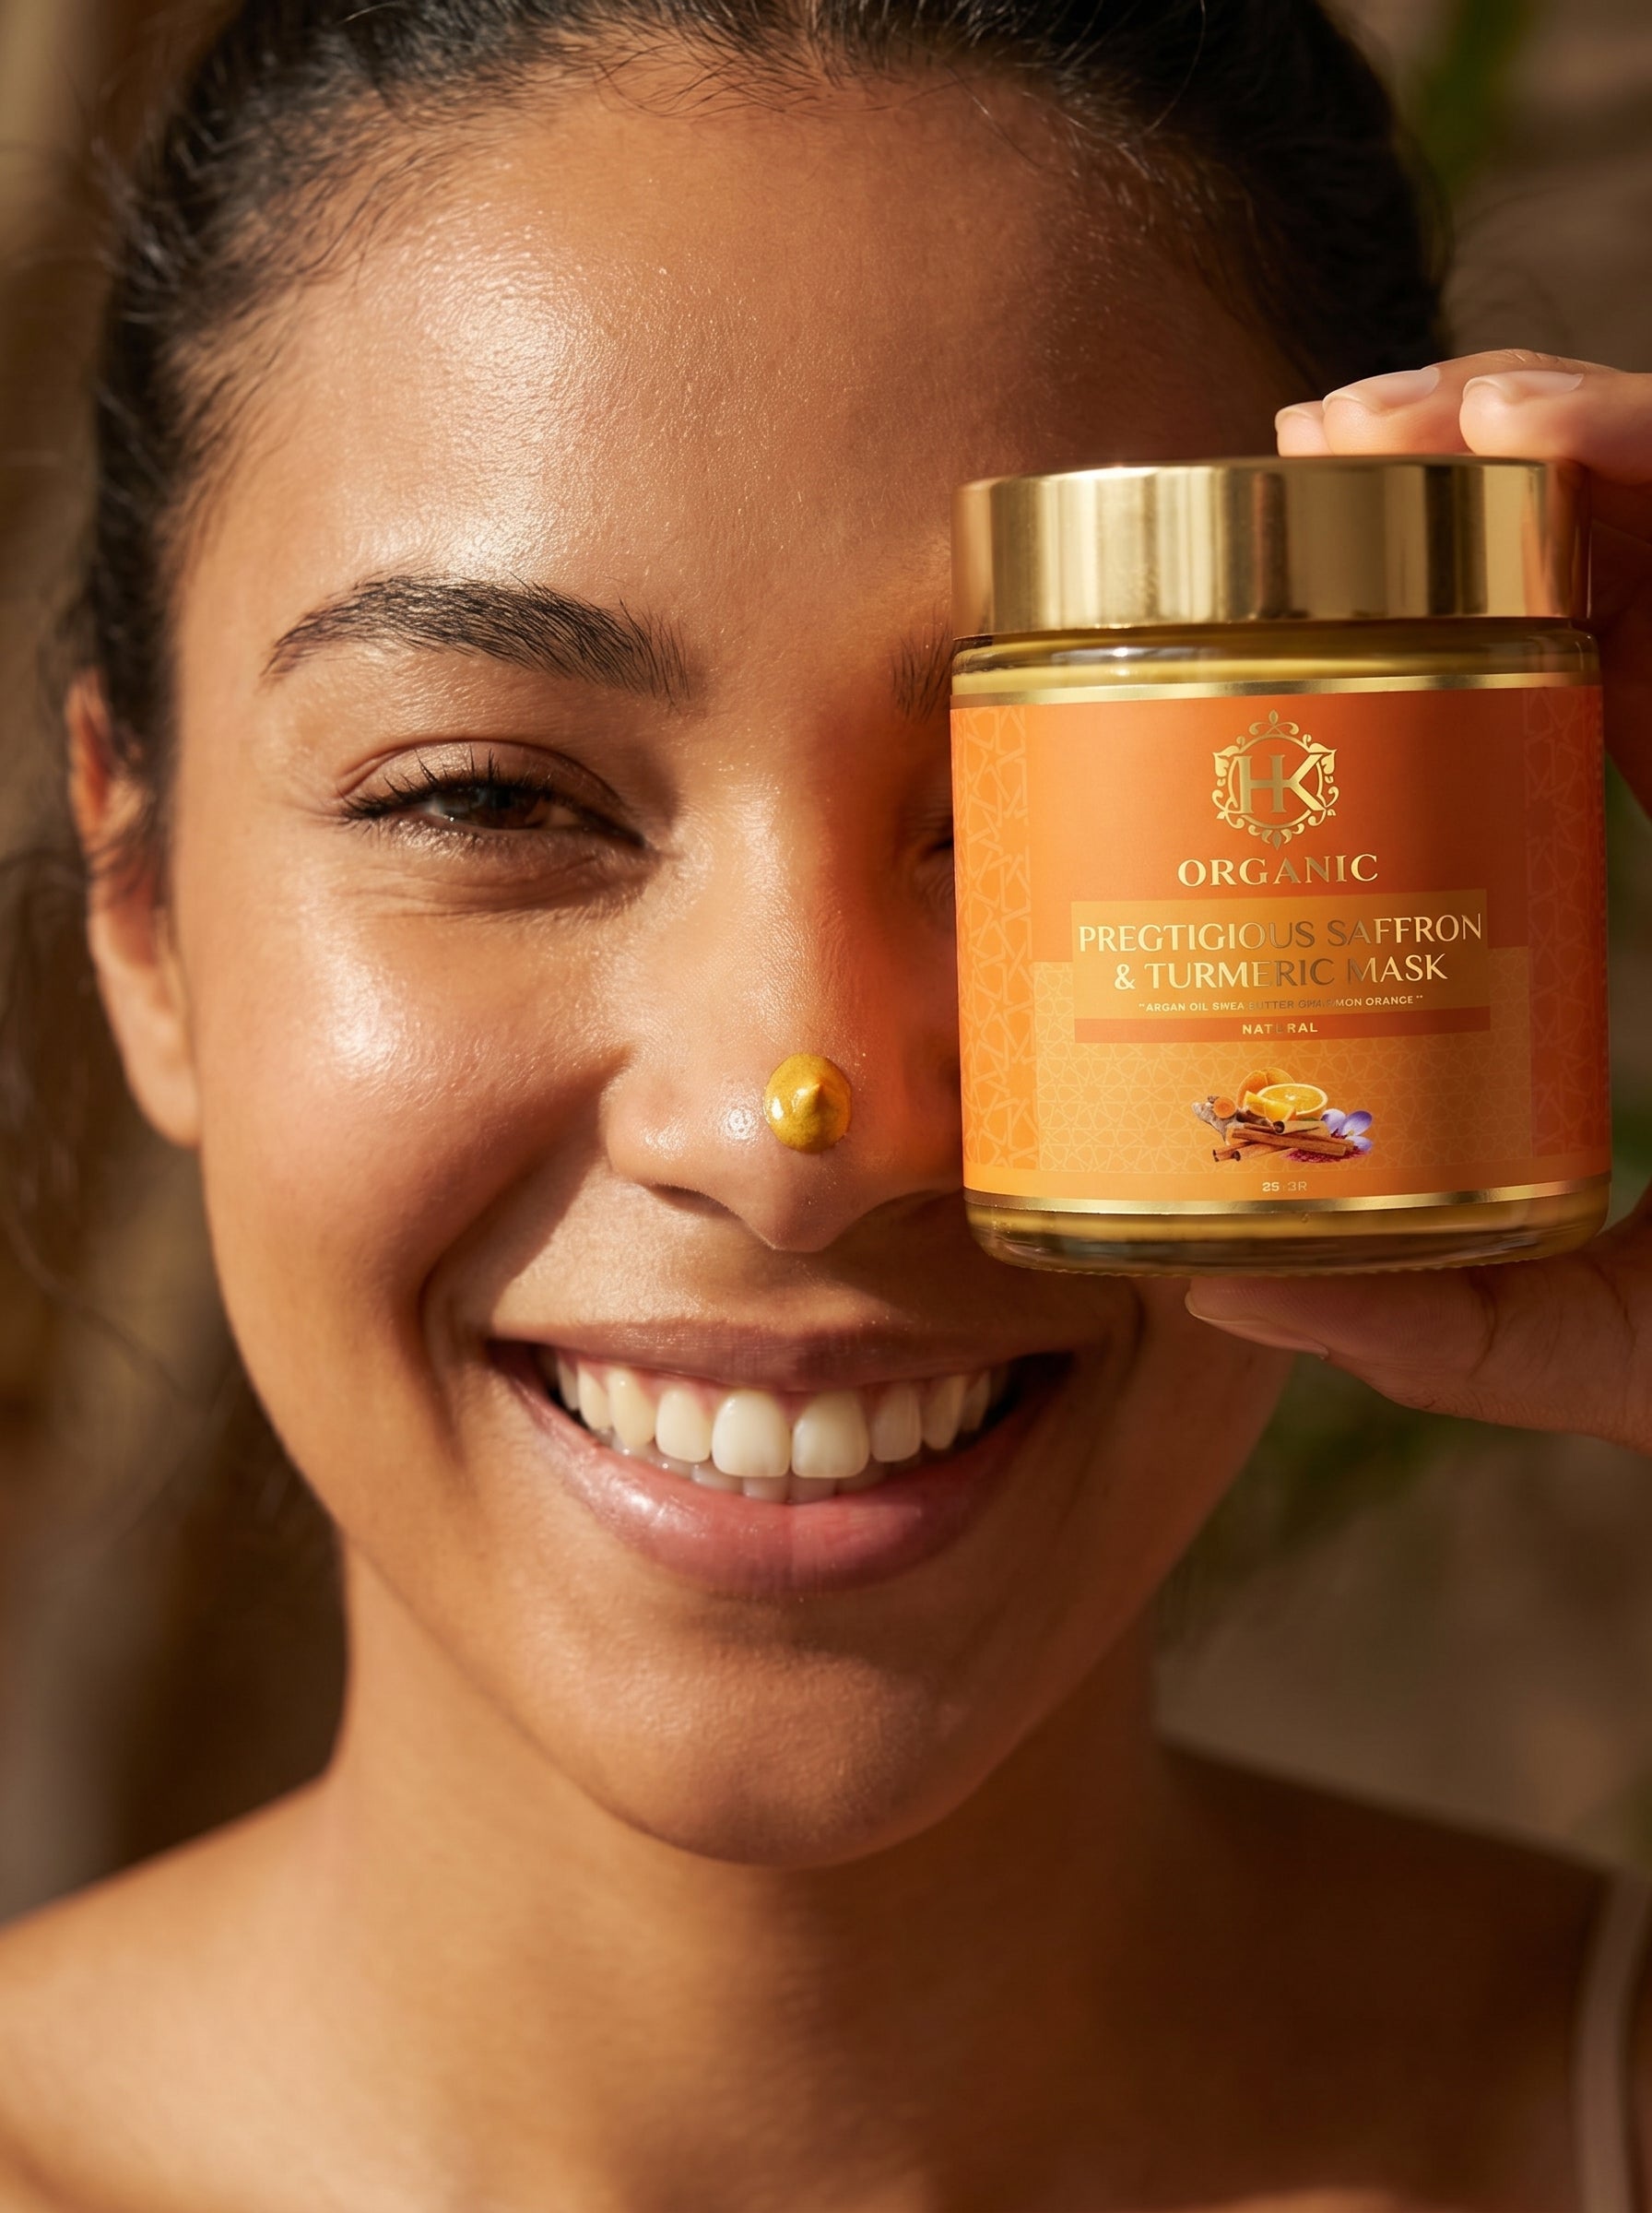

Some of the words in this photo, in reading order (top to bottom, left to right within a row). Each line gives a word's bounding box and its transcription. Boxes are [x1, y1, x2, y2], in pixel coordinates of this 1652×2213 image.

[1177, 853, 1378, 887] ORGANIC
[1079, 921, 1316, 953] PREGTIGIOUS
[1327, 912, 1482, 947] SAFFRON
[1114, 964, 1136, 990] &
[1144, 958, 1335, 989] TURMERIC
[1347, 953, 1448, 986] MASK
[1189, 1002, 1209, 1012] OIL
